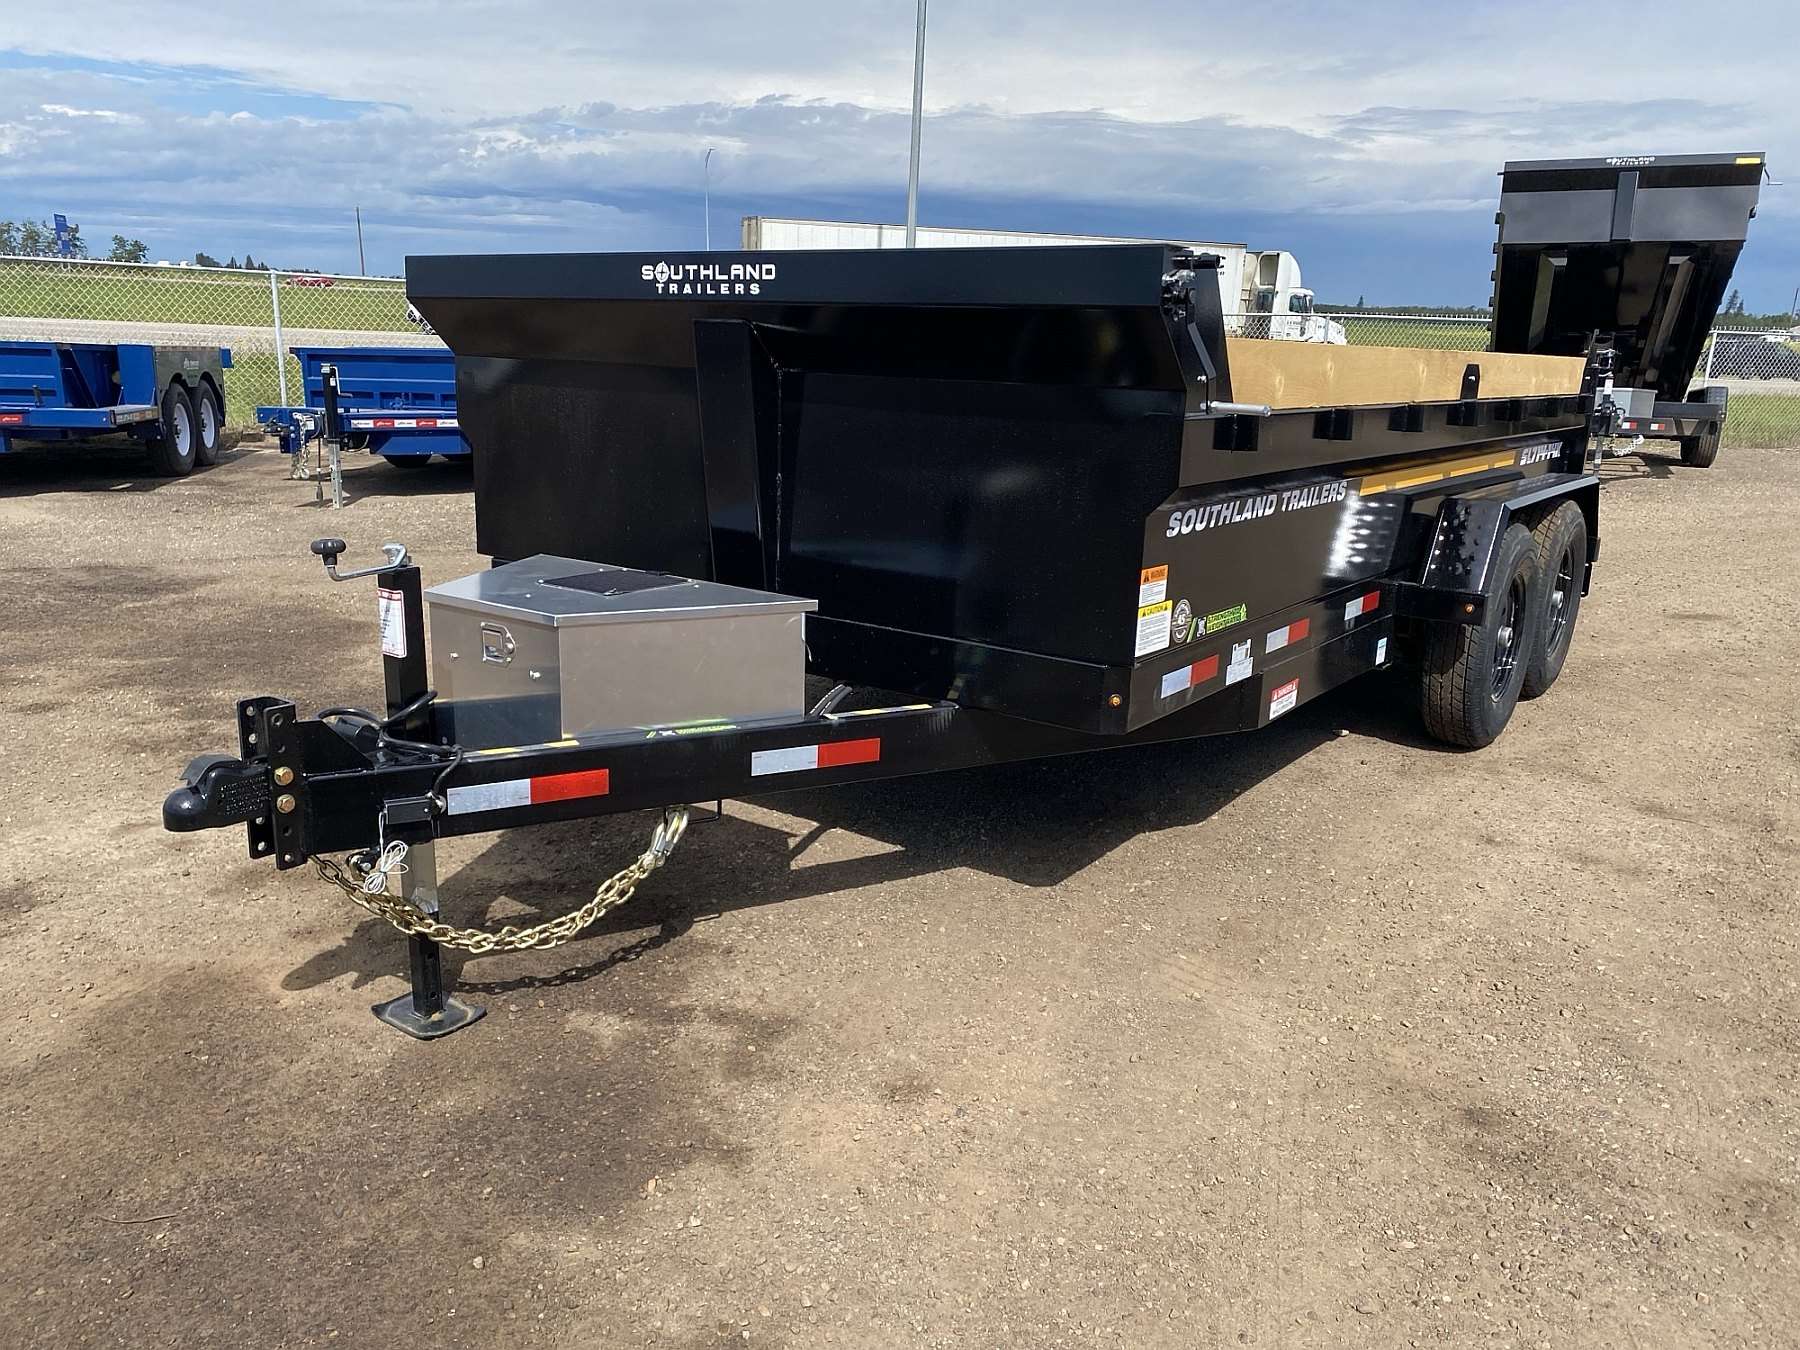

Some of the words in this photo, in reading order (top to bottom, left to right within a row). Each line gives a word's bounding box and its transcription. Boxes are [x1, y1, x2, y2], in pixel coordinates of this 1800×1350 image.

[641, 261, 776, 283] SOUTHLAND
[655, 283, 761, 295] TRAILERS
[1166, 494, 1278, 538] SOUTHLAND
[1281, 481, 1348, 512] TRAILERS
